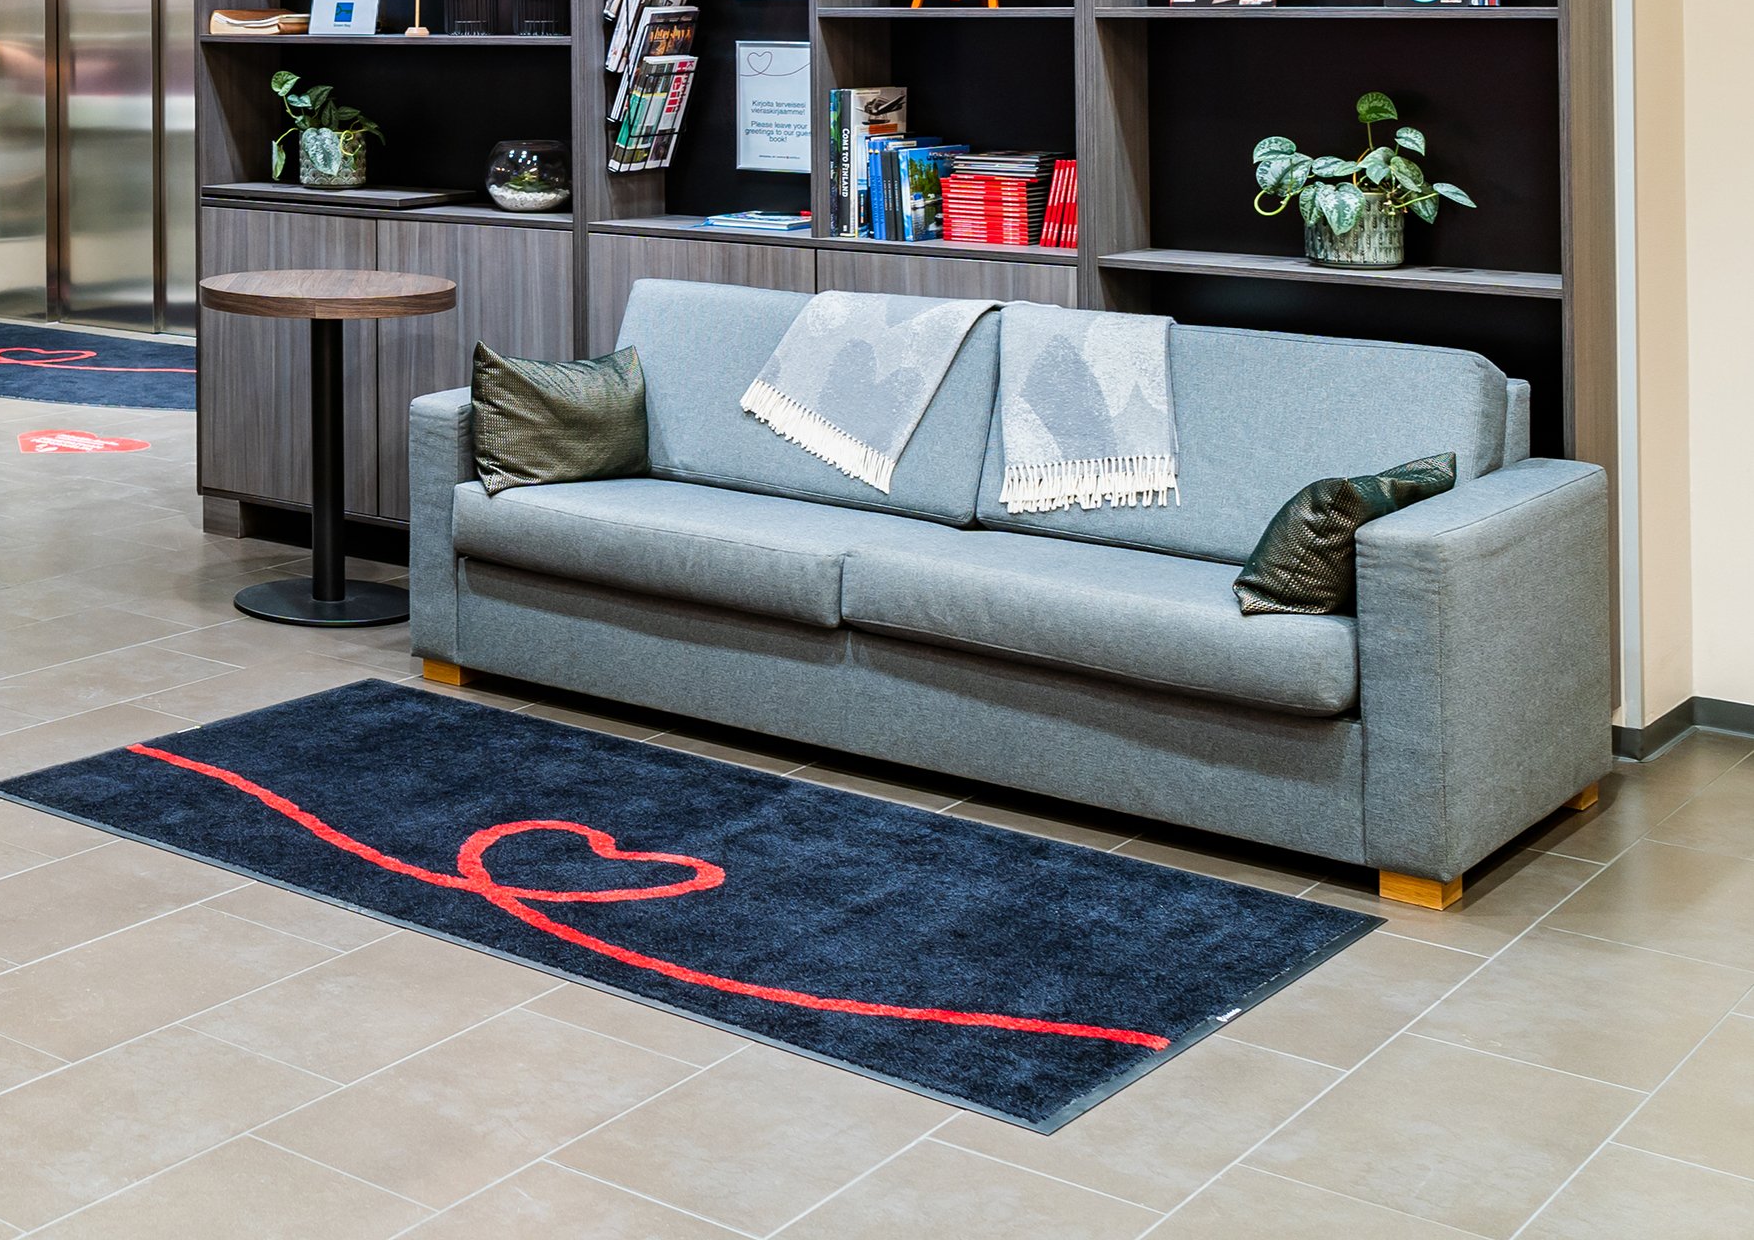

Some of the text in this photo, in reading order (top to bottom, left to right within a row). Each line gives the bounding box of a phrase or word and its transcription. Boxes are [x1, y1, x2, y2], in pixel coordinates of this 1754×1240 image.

[751, 120, 773, 128] Please
[774, 121, 791, 129] leave
[744, 128, 774, 136] greetings
[841, 128, 851, 198] COME TO FINLAND
